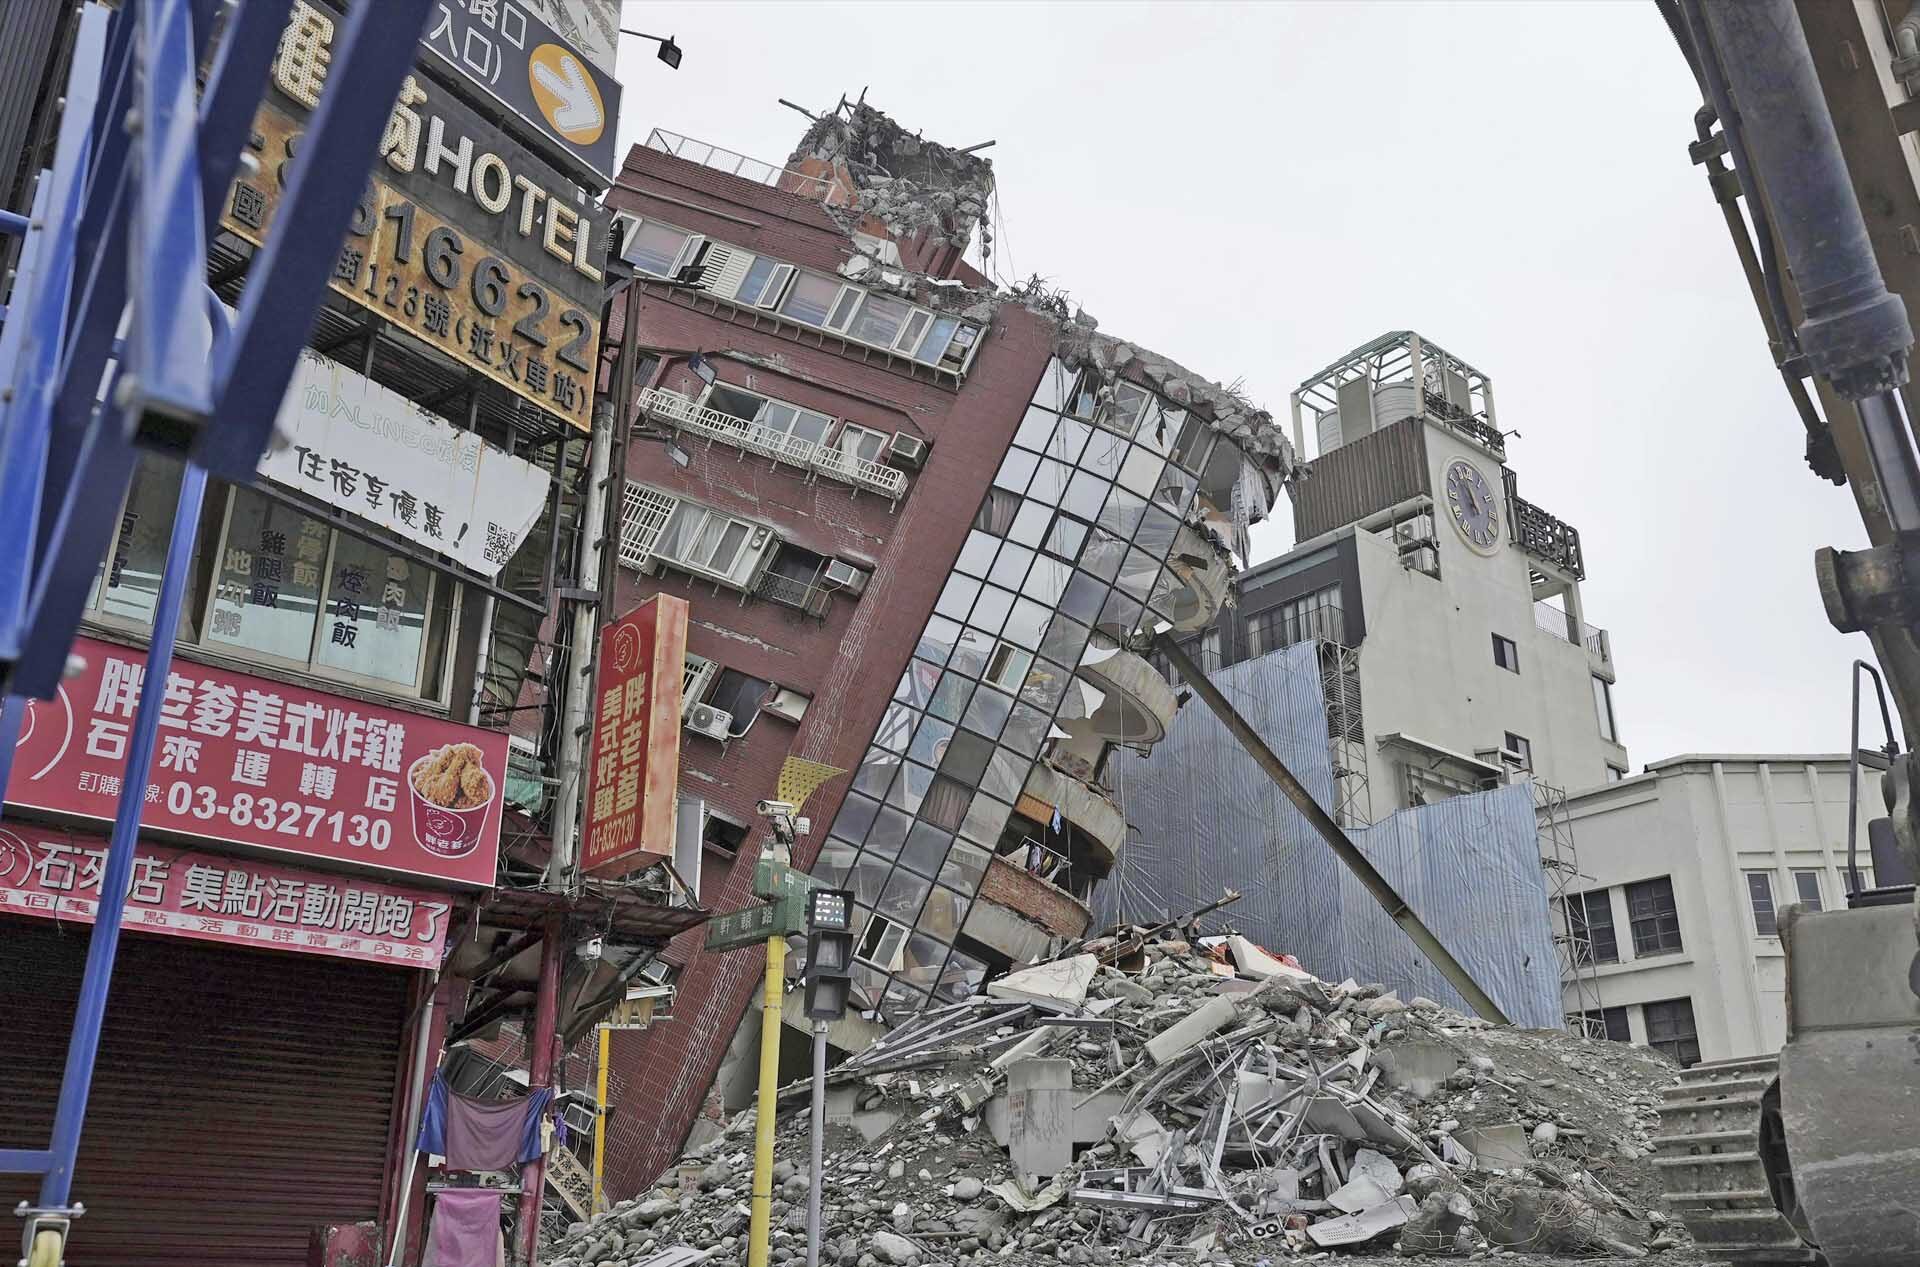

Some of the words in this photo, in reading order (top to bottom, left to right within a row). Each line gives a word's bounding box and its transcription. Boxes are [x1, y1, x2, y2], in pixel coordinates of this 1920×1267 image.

[424, 115, 602, 283] HOTEL
[376, 557, 410, 636] 肉飯
[93, 657, 406, 775] 胖老爹美式炸雞
[167, 781, 393, 852] 03-8327130
[180, 863, 450, 944] 集點活動開跑了
